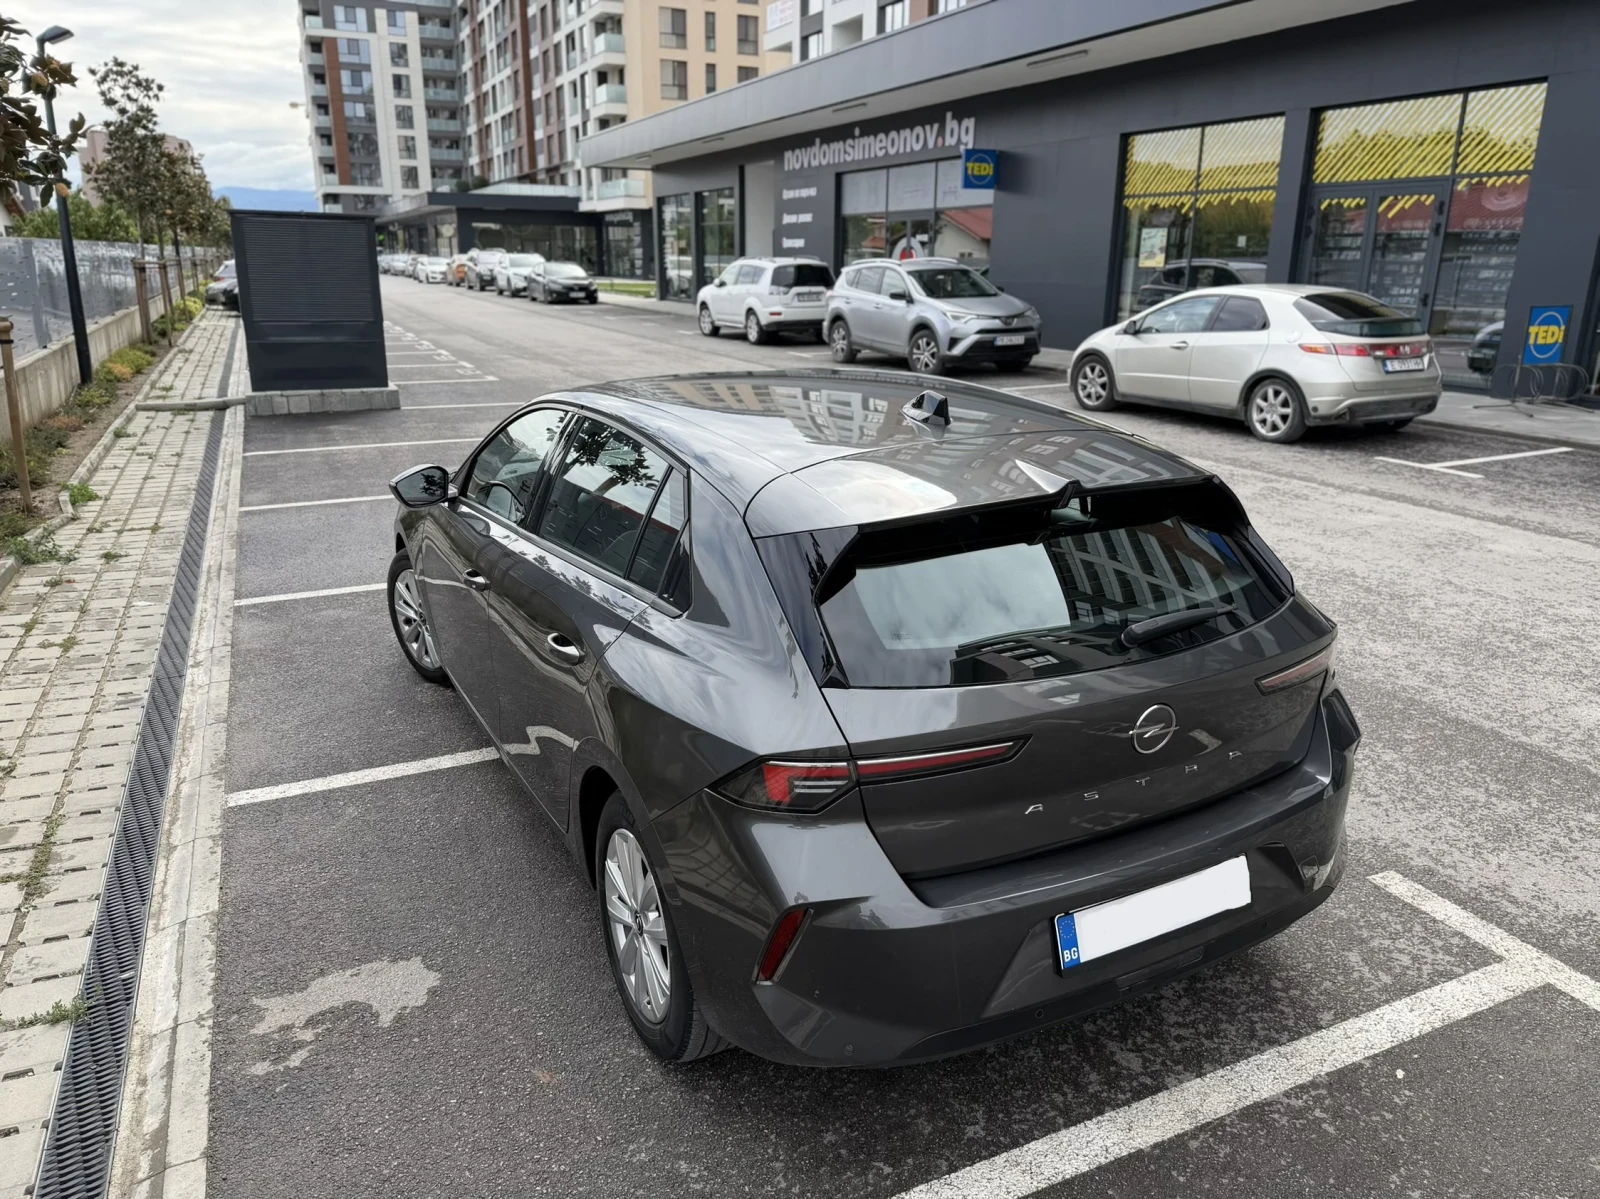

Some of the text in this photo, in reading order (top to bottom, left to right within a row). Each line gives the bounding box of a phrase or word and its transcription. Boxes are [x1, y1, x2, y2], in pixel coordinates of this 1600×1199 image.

[784, 111, 976, 171] novdomsimeonov.bg
[966, 162, 994, 176] TEDi
[1528, 325, 1566, 345] TEDi
[1025, 751, 1242, 814] ASTRA
[1063, 947, 1079, 963] BG
